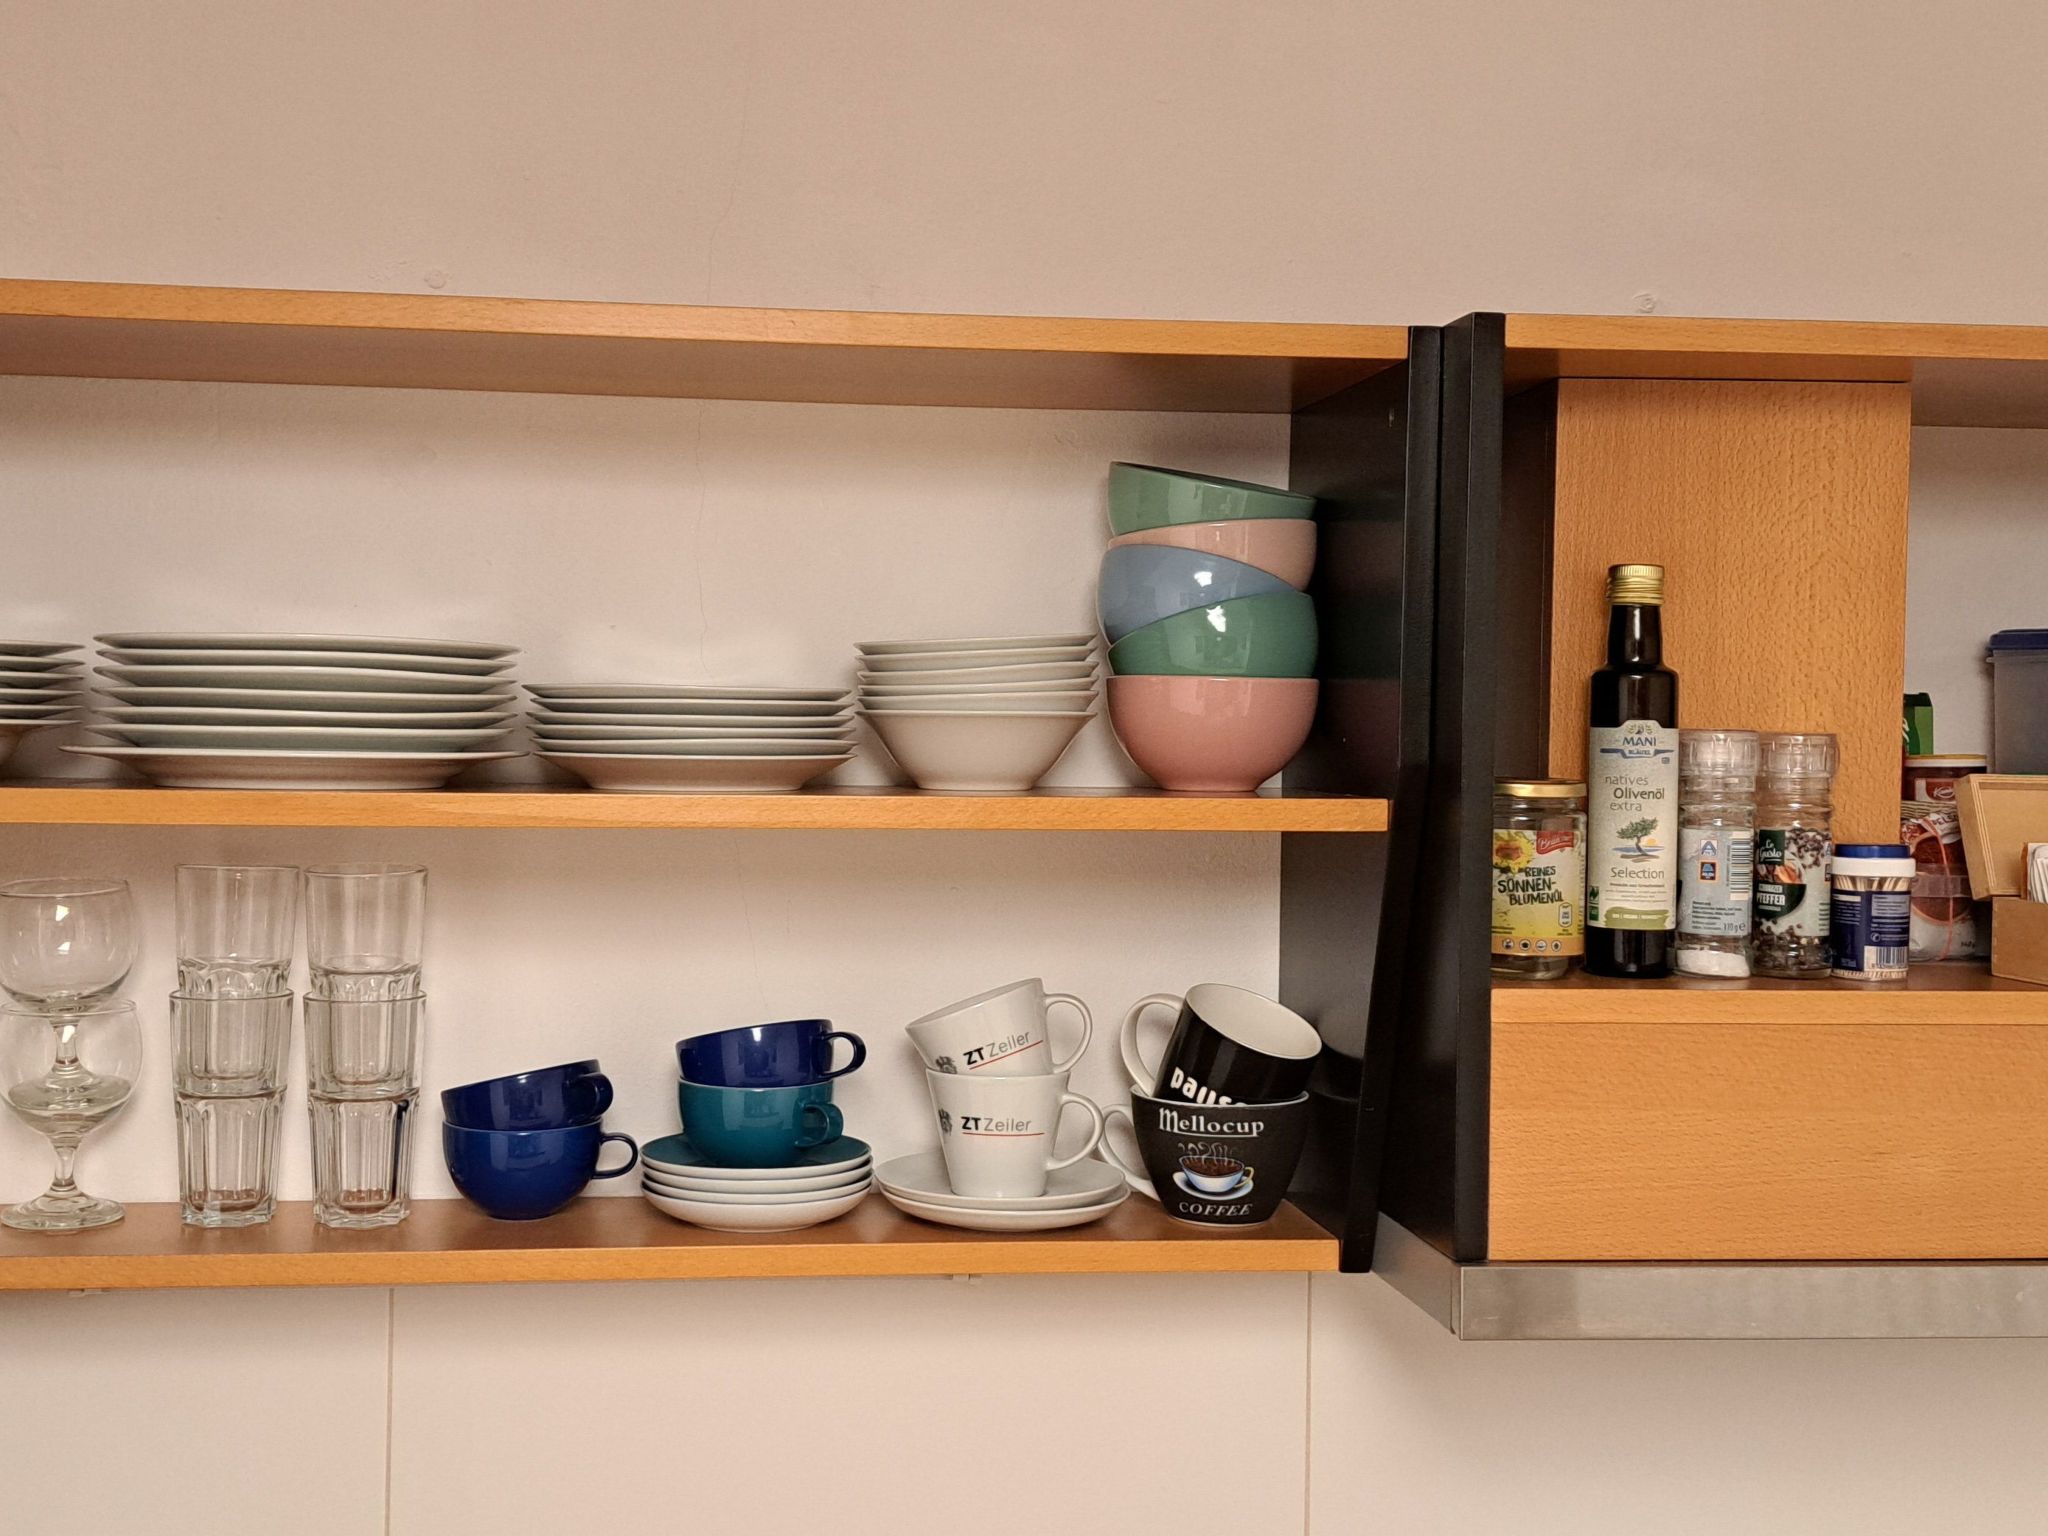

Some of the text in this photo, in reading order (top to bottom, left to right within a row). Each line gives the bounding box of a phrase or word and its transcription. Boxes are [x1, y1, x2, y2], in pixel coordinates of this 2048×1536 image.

[1622, 737, 1657, 746] MANI
[1605, 775, 1649, 785] natives
[1613, 788, 1665, 800] Olivenöl
[1610, 802, 1642, 812] extra
[1524, 866, 1556, 878] REINES
[1610, 866, 1665, 880] Selection
[963, 1032, 1029, 1065] ZT Zeiler
[961, 1116, 1032, 1132] ZT Zeiler
[1159, 1107, 1265, 1137] Mellocup
[1178, 1201, 1253, 1217] COFFEE
